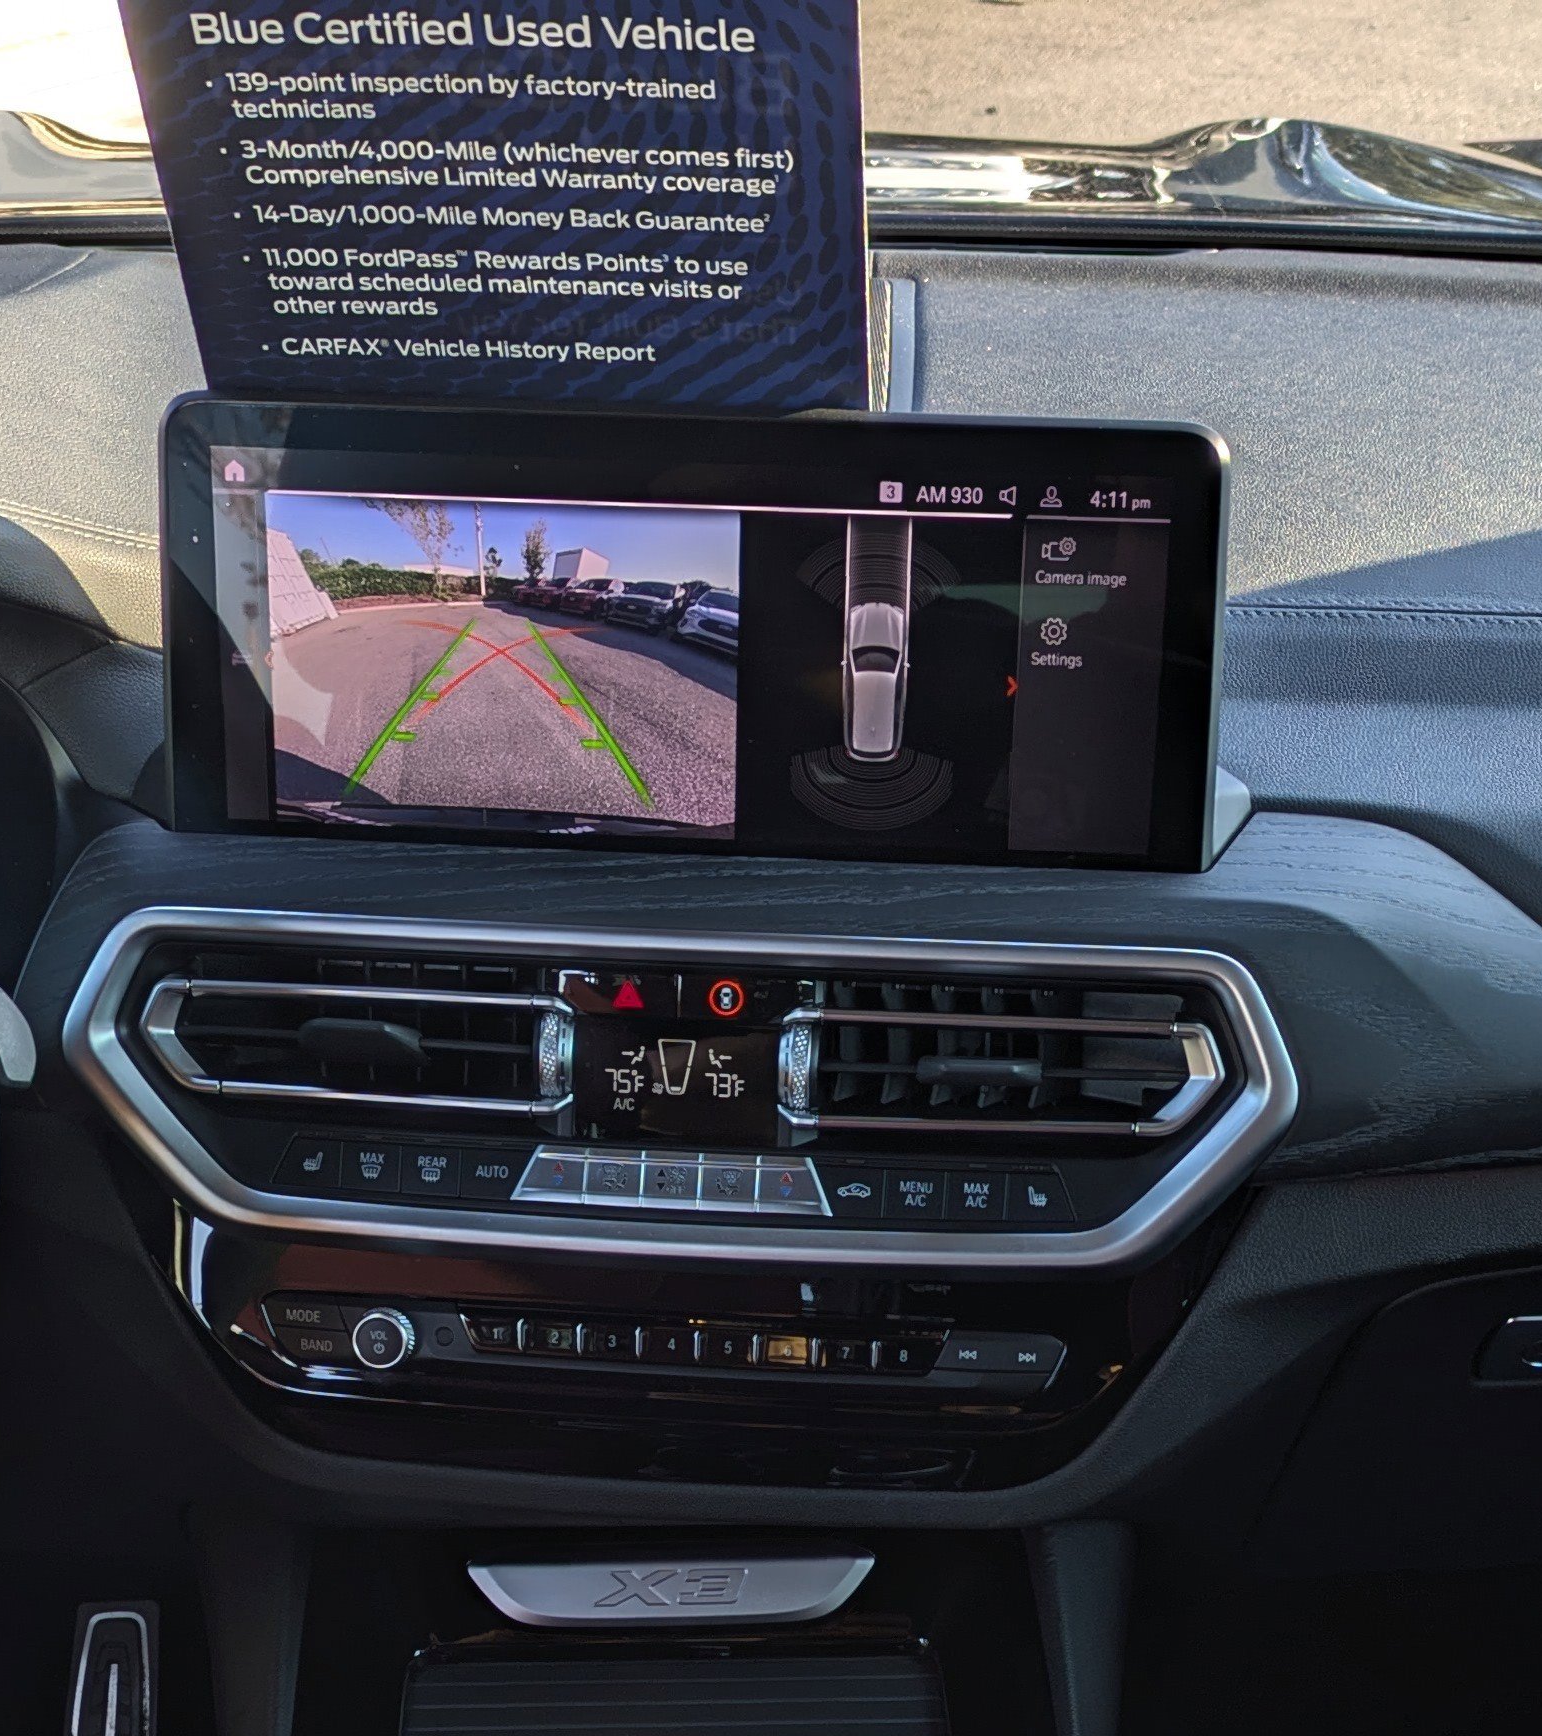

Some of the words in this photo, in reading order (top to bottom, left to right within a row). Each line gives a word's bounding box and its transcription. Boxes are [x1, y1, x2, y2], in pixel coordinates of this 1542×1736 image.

[189, 11, 286, 45] Blue
[293, 10, 474, 46] Certified
[483, 13, 592, 49] Used
[600, 16, 755, 53] Vehicle
[225, 71, 347, 96] 139-point
[350, 72, 484, 97] inspection
[487, 73, 519, 99] by
[523, 74, 717, 101] factory-trained
[230, 97, 377, 119] technicians
[239, 139, 497, 163] 3-Month/4,000-Mile
[503, 141, 640, 166] (whichever
[645, 149, 730, 168] comes
[733, 147, 794, 174] first)
[245, 164, 439, 188] Comprehensive
[443, 166, 537, 188] Limited
[541, 168, 658, 194] Warranty
[252, 204, 478, 227] 14-Day/1,000-Mile
[482, 206, 564, 231] Money
[569, 208, 631, 229] Back
[261, 247, 339, 269] 11,000
[473, 250, 582, 271] Rewards
[673, 256, 700, 275] to
[705, 260, 749, 276] use
[267, 272, 355, 291] toward
[358, 272, 483, 293] scheduled
[487, 275, 645, 297] maintenance
[648, 279, 713, 299] visits
[717, 284, 743, 300] or
[273, 295, 337, 315] other
[341, 296, 439, 316] rewards
[393, 338, 481, 357] Vehicle
[485, 339, 570, 363] History
[574, 341, 657, 364] Report
[915, 485, 947, 503] AM
[950, 486, 984, 505] 930
[1089, 490, 1128, 509] 4:11
[1131, 498, 1151, 511] pm
[1035, 569, 1084, 585] Camera
[1086, 571, 1128, 590] image
[1030, 651, 1083, 670] Settings
[613, 1097, 635, 1112] A/C
[359, 1152, 385, 1164] MAX
[417, 1155, 448, 1168] REAR
[475, 1165, 509, 1179] AUTO
[899, 1180, 934, 1195] MENU
[963, 1182, 990, 1195] MAX
[904, 1193, 927, 1207] A/C
[964, 1194, 988, 1209] A/C
[285, 1308, 321, 1324] MODE
[369, 1330, 388, 1341] VOL
[549, 1331, 560, 1344] 2
[608, 1334, 617, 1348] 3
[300, 1338, 333, 1353] BAND
[667, 1337, 676, 1351] 4
[723, 1340, 733, 1355] 5
[842, 1346, 850, 1360] 7
[899, 1348, 909, 1362] 8
[593, 1568, 749, 1608] X3
